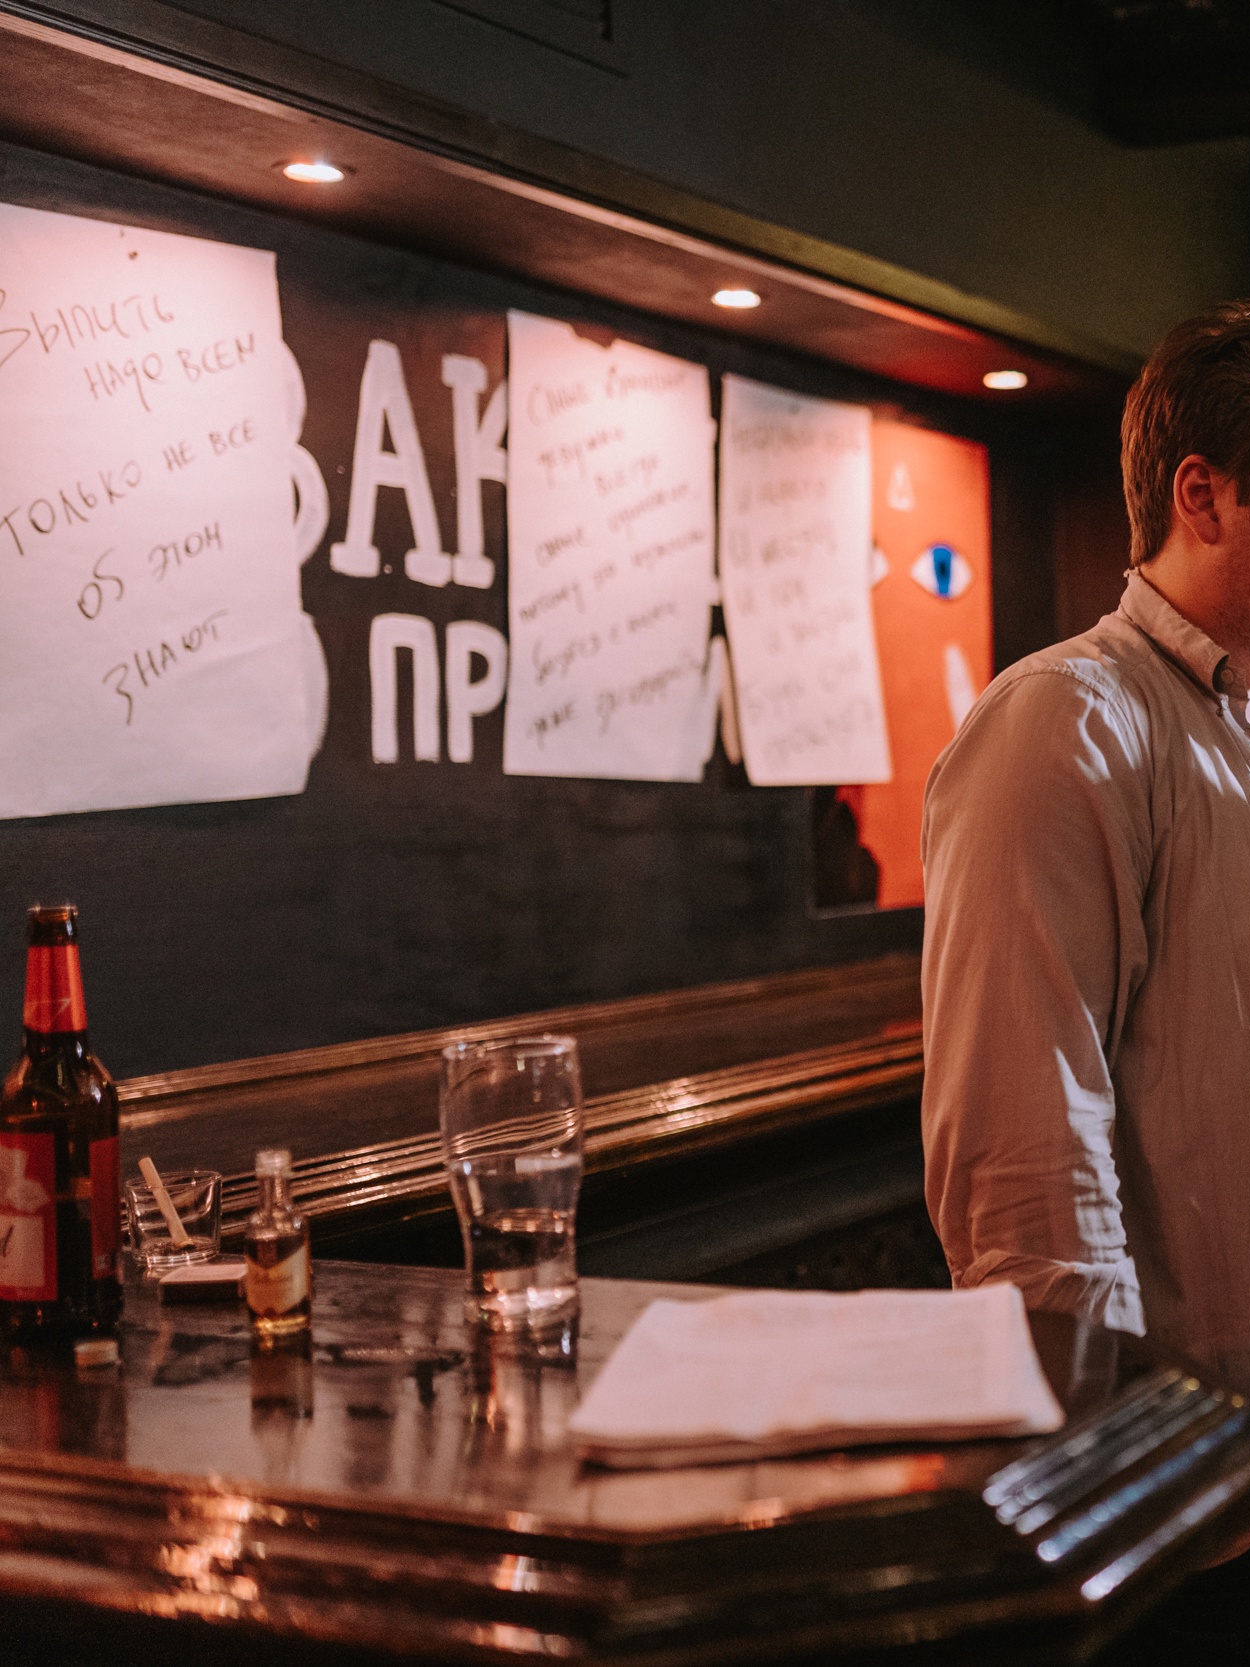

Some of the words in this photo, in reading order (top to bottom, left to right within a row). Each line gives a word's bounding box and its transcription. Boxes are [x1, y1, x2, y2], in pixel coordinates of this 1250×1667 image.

[0, 461, 142, 556] ТОЛЬКО
[162, 441, 197, 472] НЕ
[208, 419, 257, 457] ВСЕ
[102, 608, 229, 726] ЗНАЮТ
